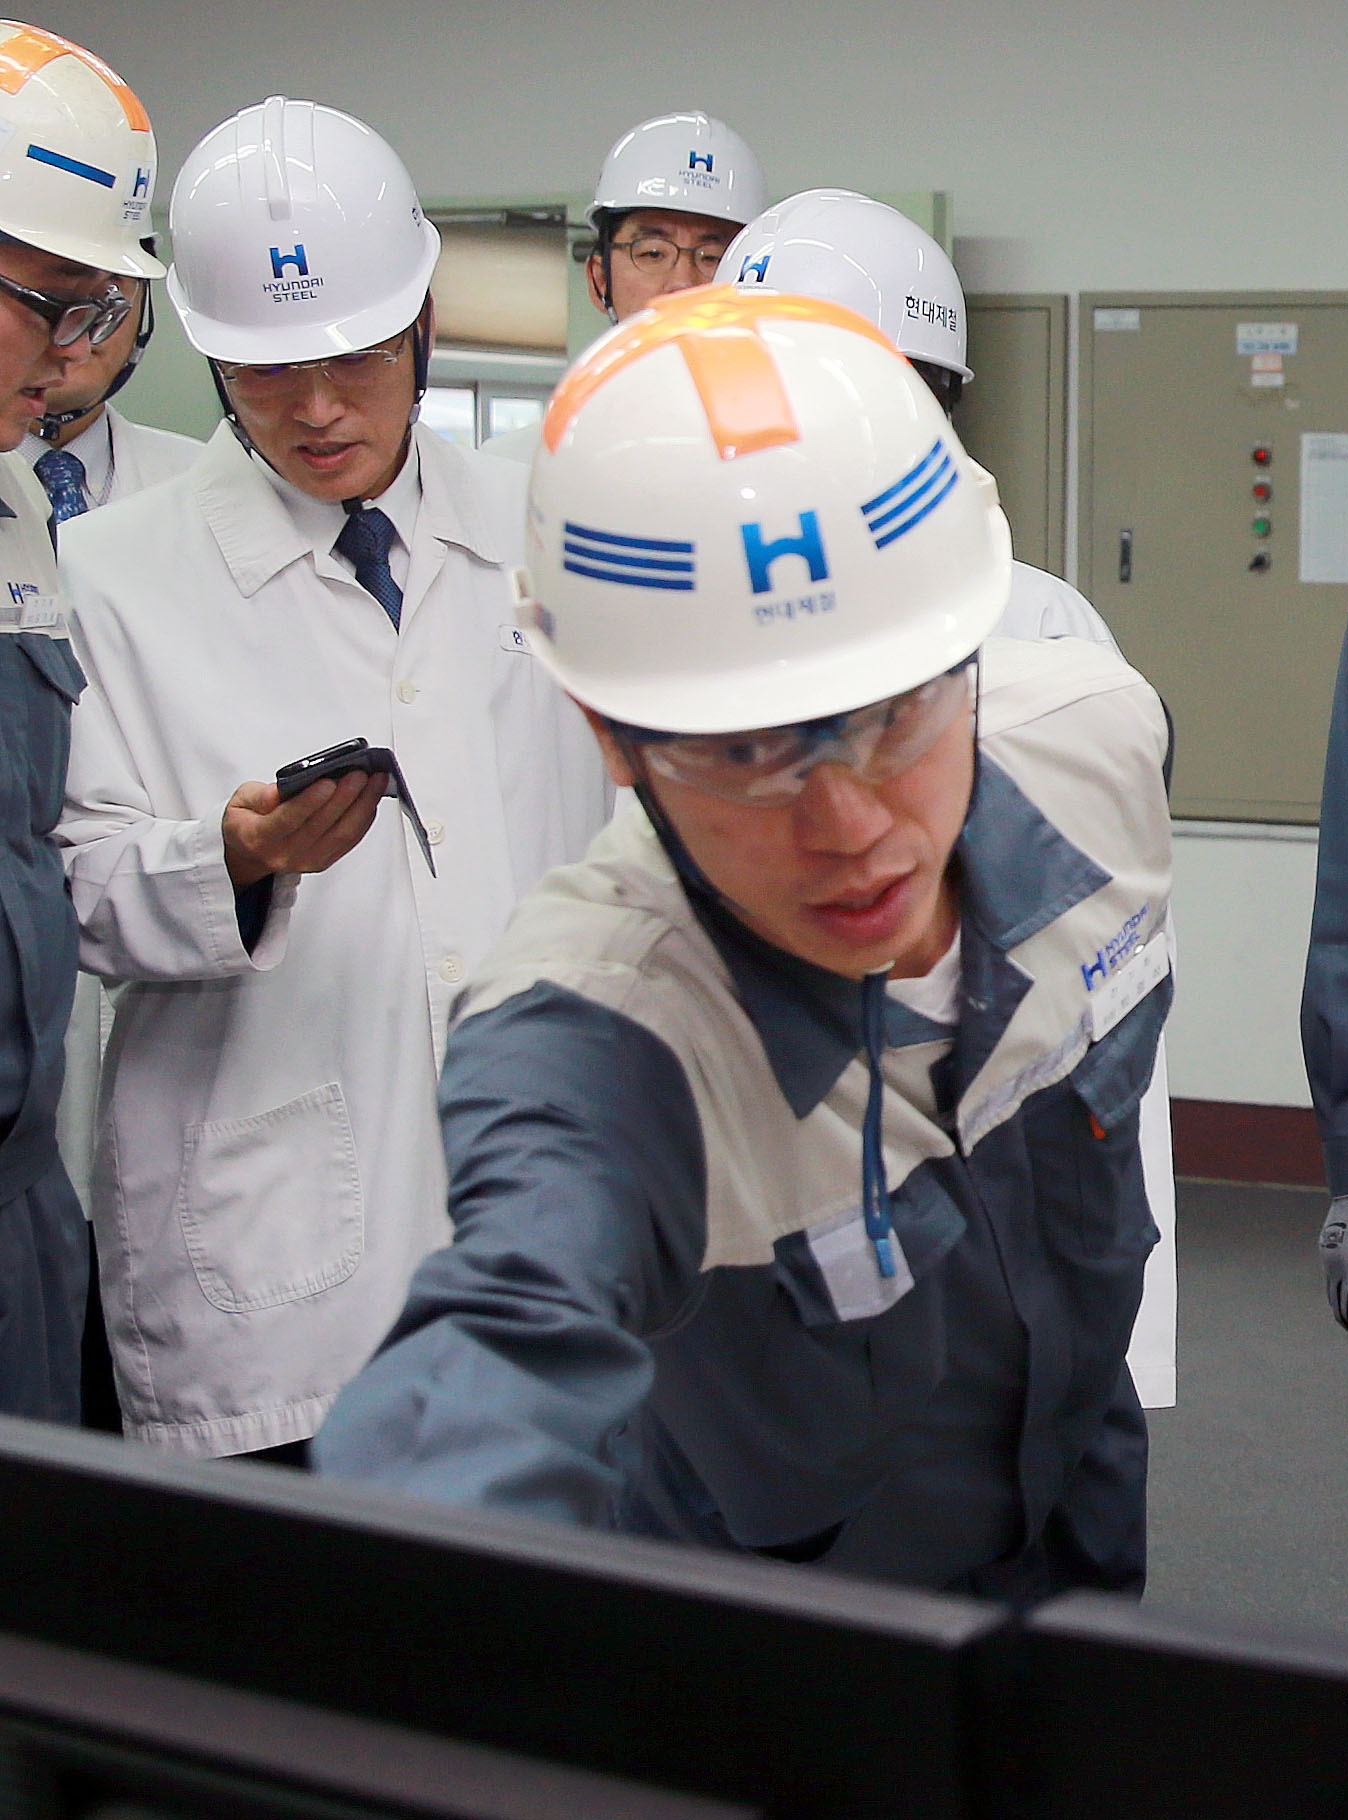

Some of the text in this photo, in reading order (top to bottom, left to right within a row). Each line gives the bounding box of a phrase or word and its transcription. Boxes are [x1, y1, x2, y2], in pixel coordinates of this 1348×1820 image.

[262, 276, 325, 293] HYUNDAI
[272, 290, 318, 304] STEEL
[904, 294, 958, 333] 현대제철
